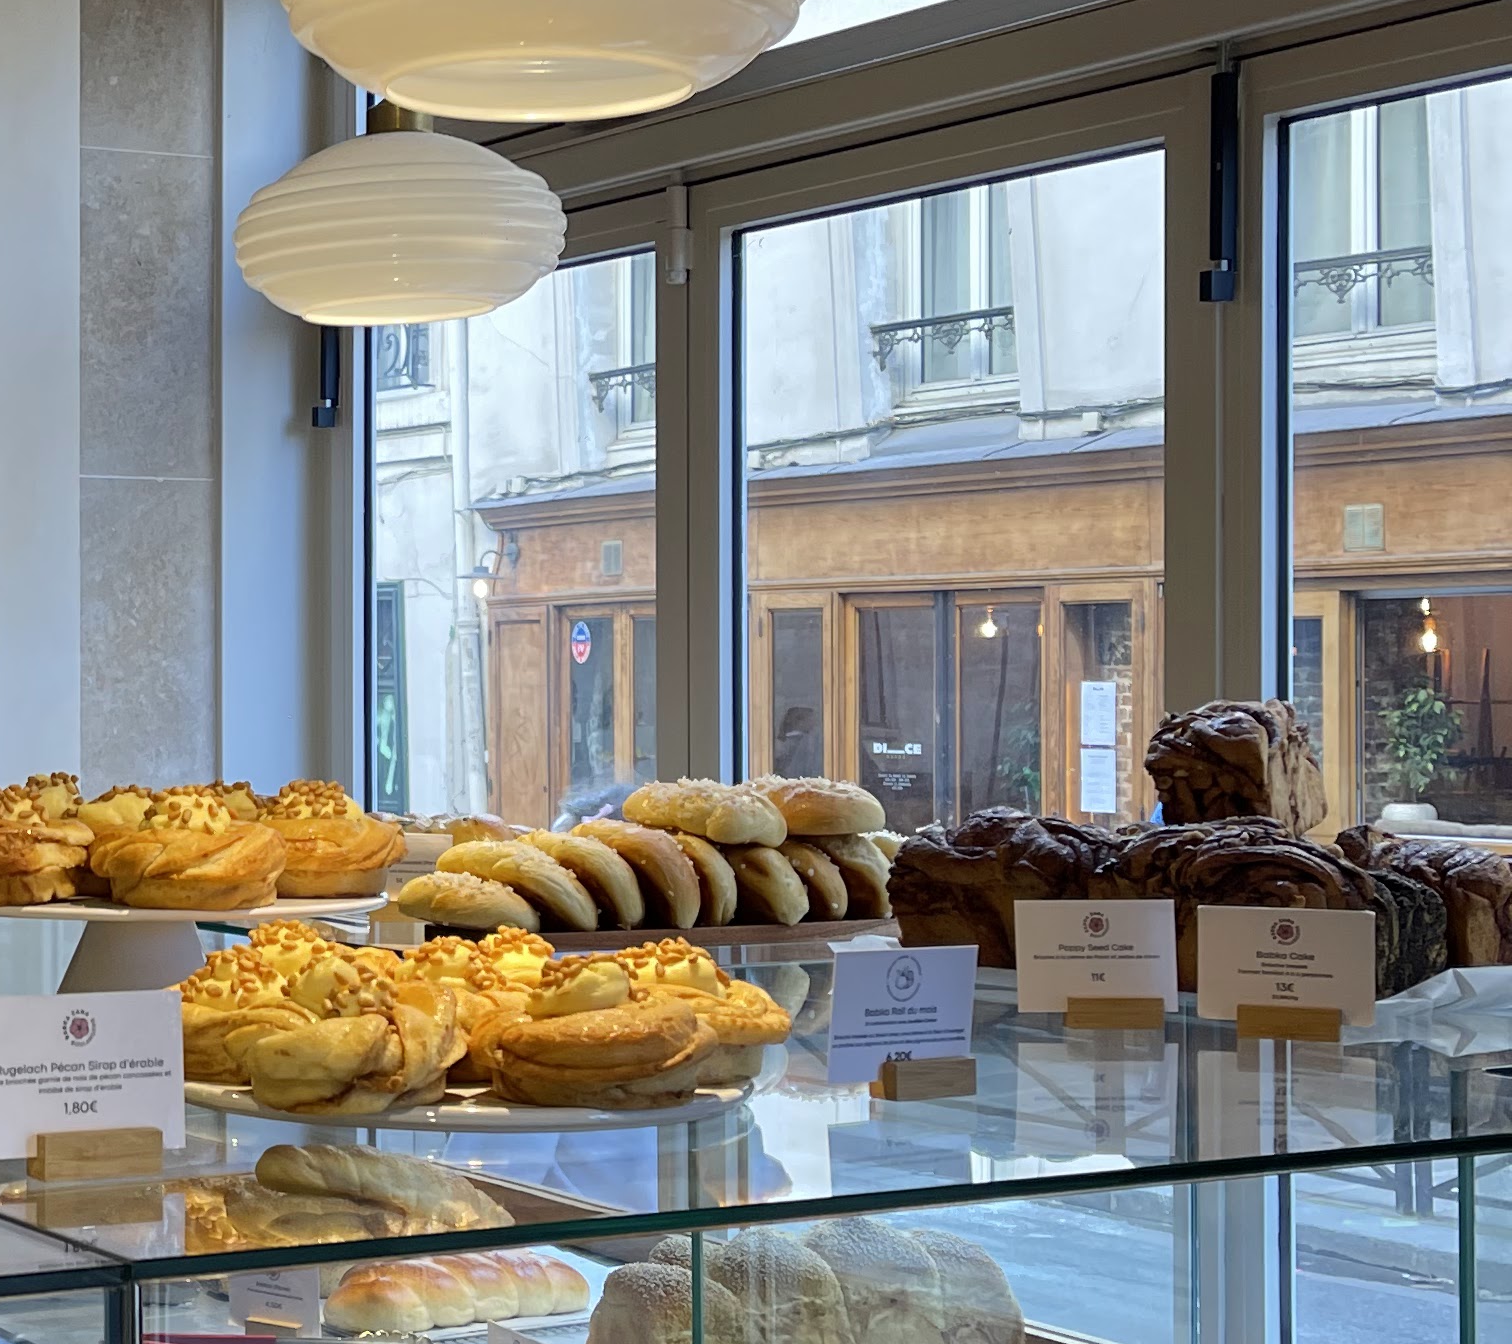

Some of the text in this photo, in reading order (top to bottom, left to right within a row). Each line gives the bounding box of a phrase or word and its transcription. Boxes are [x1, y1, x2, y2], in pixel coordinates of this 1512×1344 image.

[1058, 944, 1134, 953] Poppy Seed Cake
[1256, 951, 1315, 961] Babka Cake
[1275, 982, 1295, 992] 13€
[892, 1006, 906, 1015] Roll
[50, 1060, 86, 1073] Pécan
[88, 1059, 117, 1072] Sirop
[119, 1057, 164, 1070] d'érable
[63, 1100, 99, 1116] 1,80€
